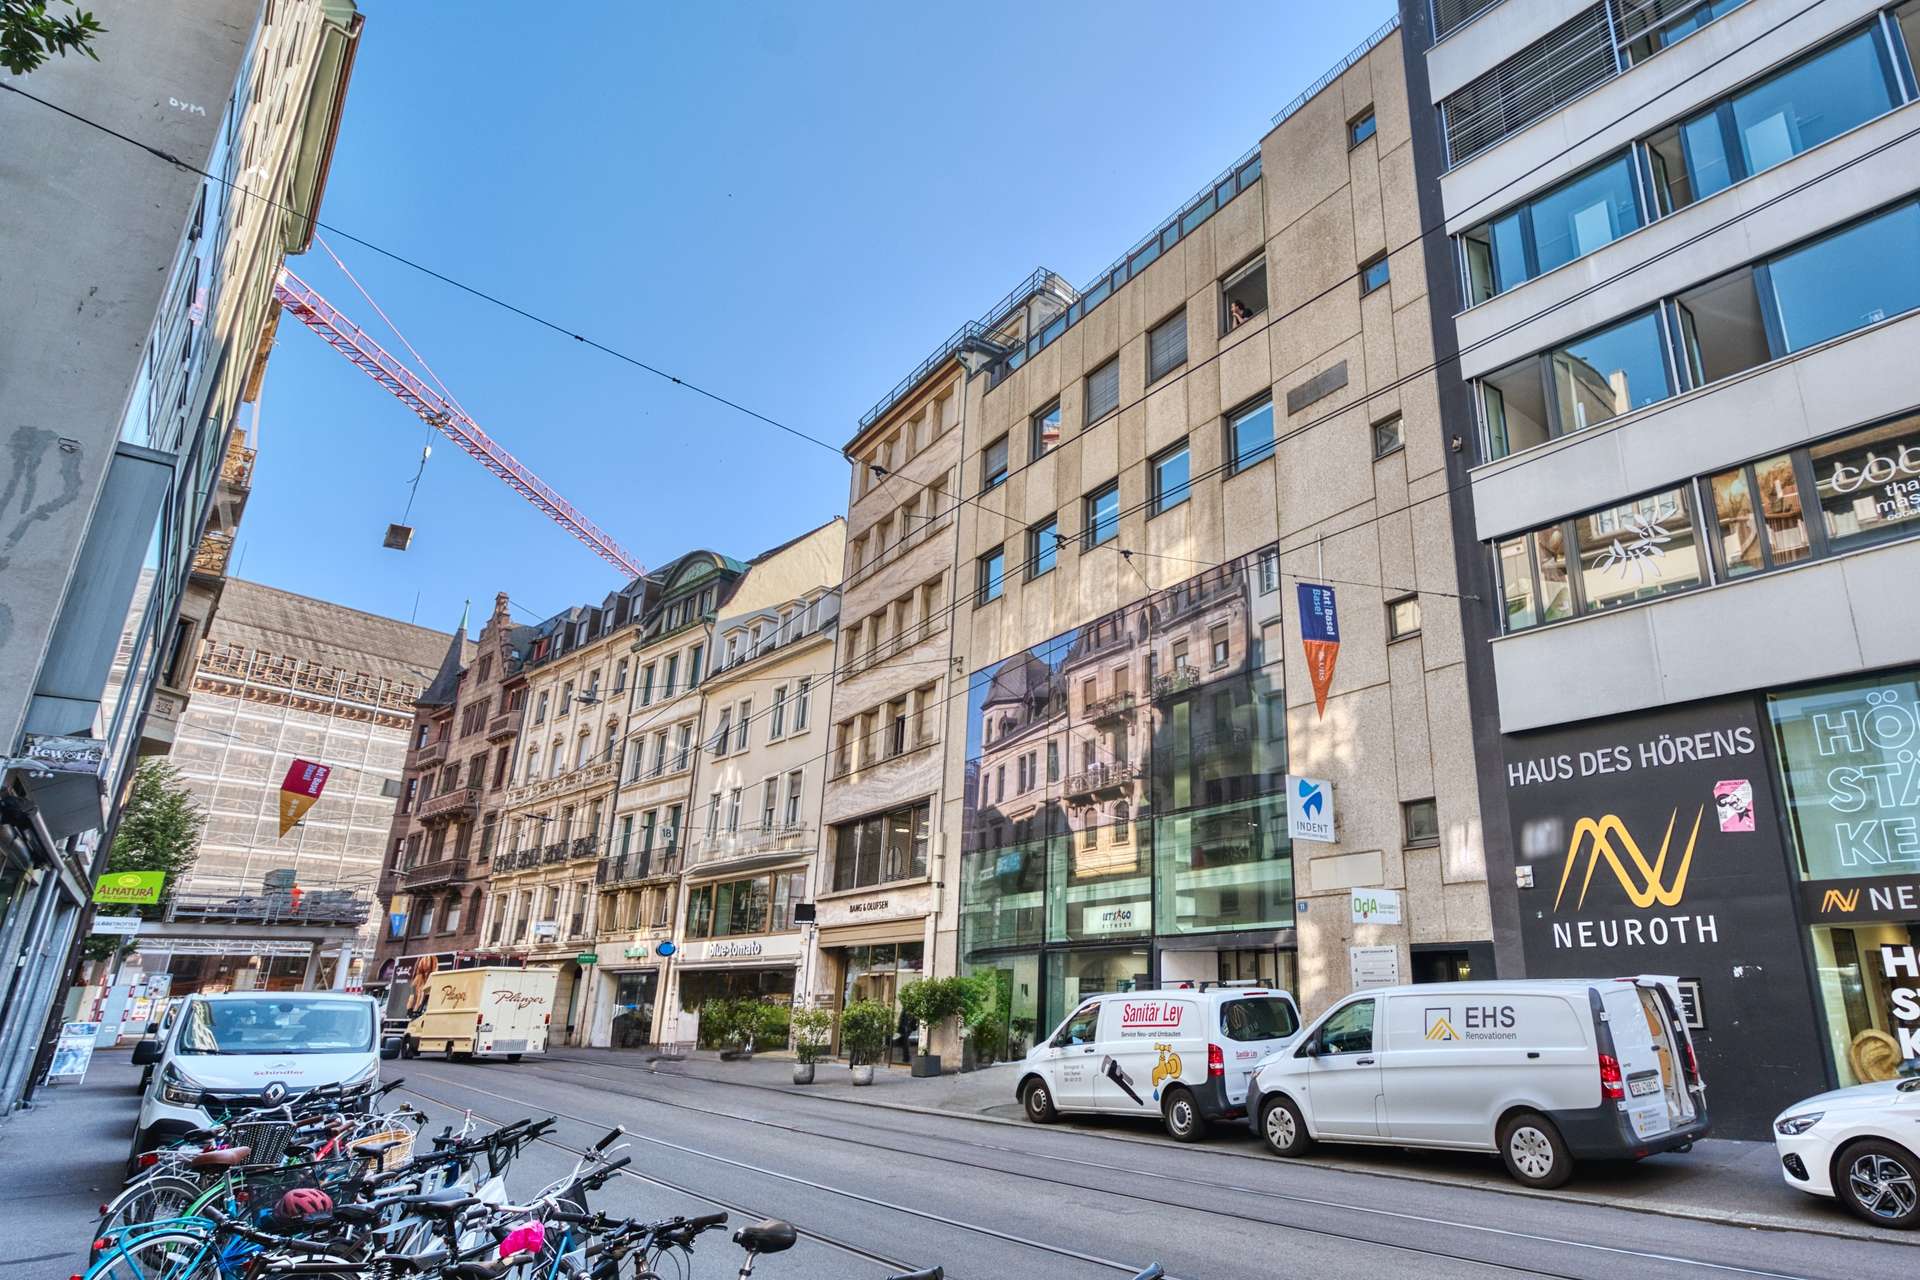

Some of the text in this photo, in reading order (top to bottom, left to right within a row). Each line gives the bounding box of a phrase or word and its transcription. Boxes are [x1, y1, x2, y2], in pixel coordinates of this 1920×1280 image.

[1884, 476, 1920, 497] tha
[1312, 588, 1323, 616] Basel
[1322, 588, 1336, 636] Art Basel
[1812, 689, 1920, 757] HÖ
[27, 745, 101, 762] Rework
[1508, 726, 1756, 787] HAUS DES HÖRENS
[662, 827, 672, 838] 18
[1296, 821, 1329, 833] INDENT
[97, 884, 154, 897] ALNATURA
[1869, 886, 1920, 911] NE
[849, 903, 863, 913] BANG
[867, 900, 889, 911] OLUFSEN
[1121, 910, 1132, 920] GO
[1353, 897, 1378, 914] OdA
[1553, 914, 1718, 949] NEUROTH
[1881, 945, 1920, 978] H
[492, 990, 547, 1010] Planzer
[1891, 987, 1920, 1021] S
[1123, 1001, 1184, 1025] Sanitär Ley
[1465, 1005, 1516, 1029] EHS
[1465, 1031, 1517, 1041] Renovationen
